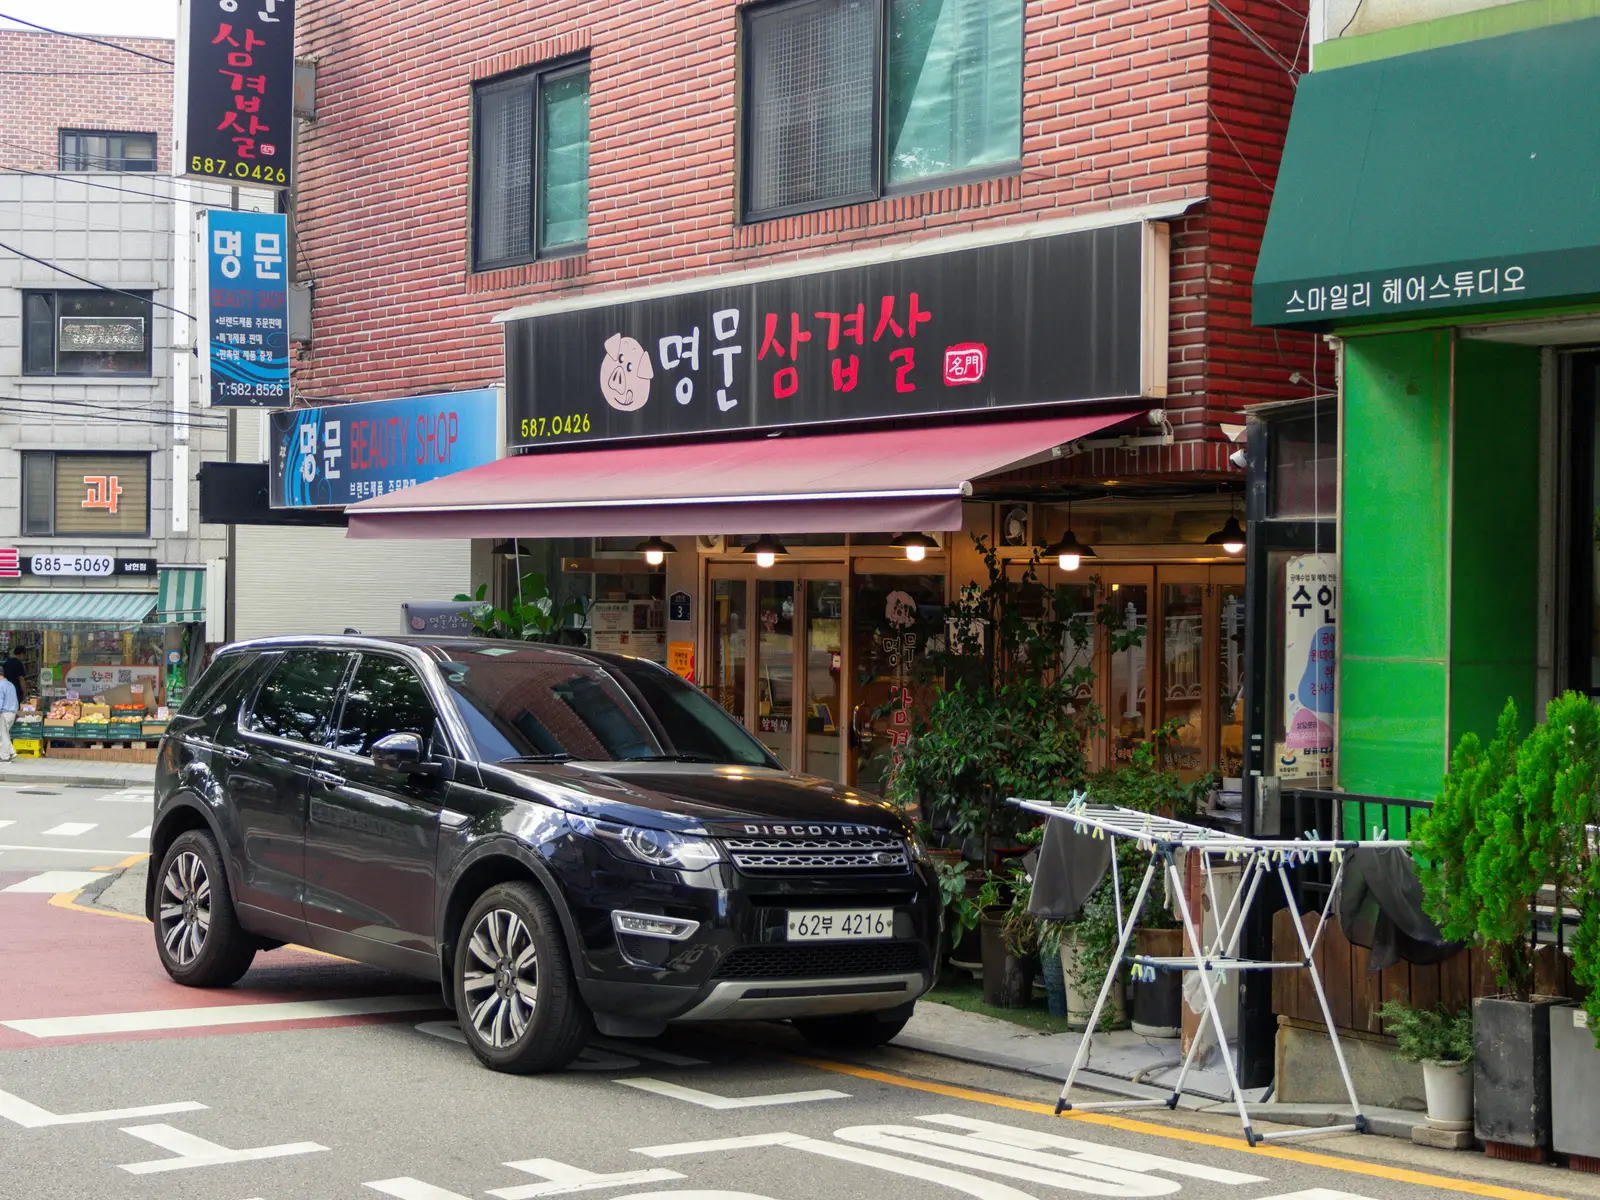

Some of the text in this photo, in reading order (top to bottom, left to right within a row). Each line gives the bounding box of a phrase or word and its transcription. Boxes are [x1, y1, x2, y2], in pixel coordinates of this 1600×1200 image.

[211, 22, 271, 159] 삼겹살
[191, 155, 287, 183] 587.0426
[213, 229, 283, 280] 명문
[211, 289, 286, 310] BEAUTY SHOP
[1285, 266, 1526, 313] 스마일리 헤어스튜디오
[658, 292, 933, 412] 명문 삼겹살
[217, 382, 284, 398] T:582.8526
[350, 411, 459, 470] BEAUTY SHOP
[520, 412, 592, 438] 587.0426
[300, 420, 342, 483] 명문
[82, 475, 123, 514] 과
[34, 557, 111, 573] 585-5069
[743, 823, 882, 836] DISCOVERY
[797, 912, 885, 936] 62부 4216
